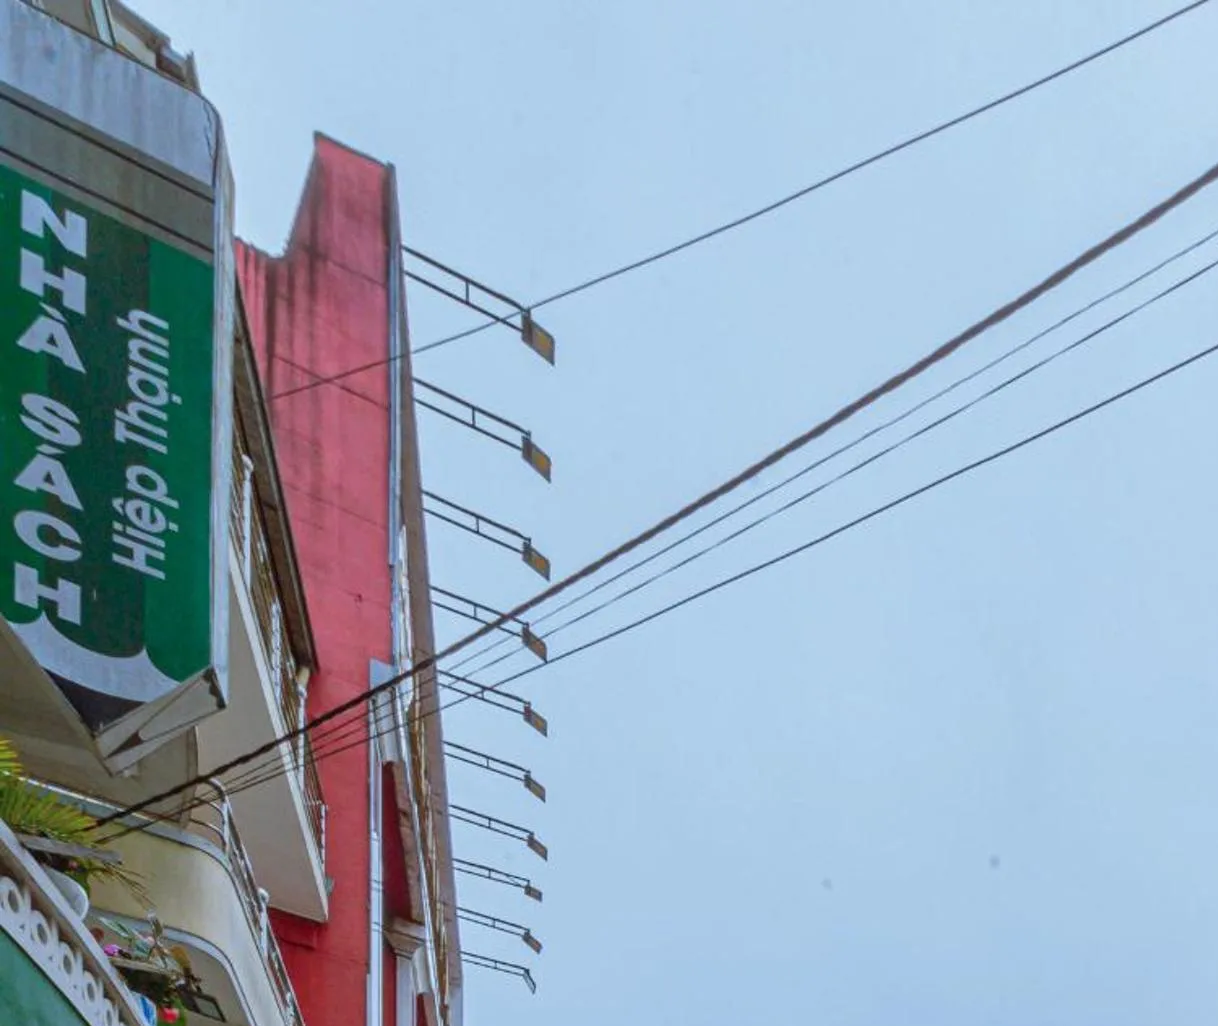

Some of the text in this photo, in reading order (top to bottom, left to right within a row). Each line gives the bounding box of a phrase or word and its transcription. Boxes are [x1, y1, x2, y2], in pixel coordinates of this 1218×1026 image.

[13, 188, 88, 627] NHÀ SÁCH
[111, 305, 184, 580] Hiệp Thạnh
